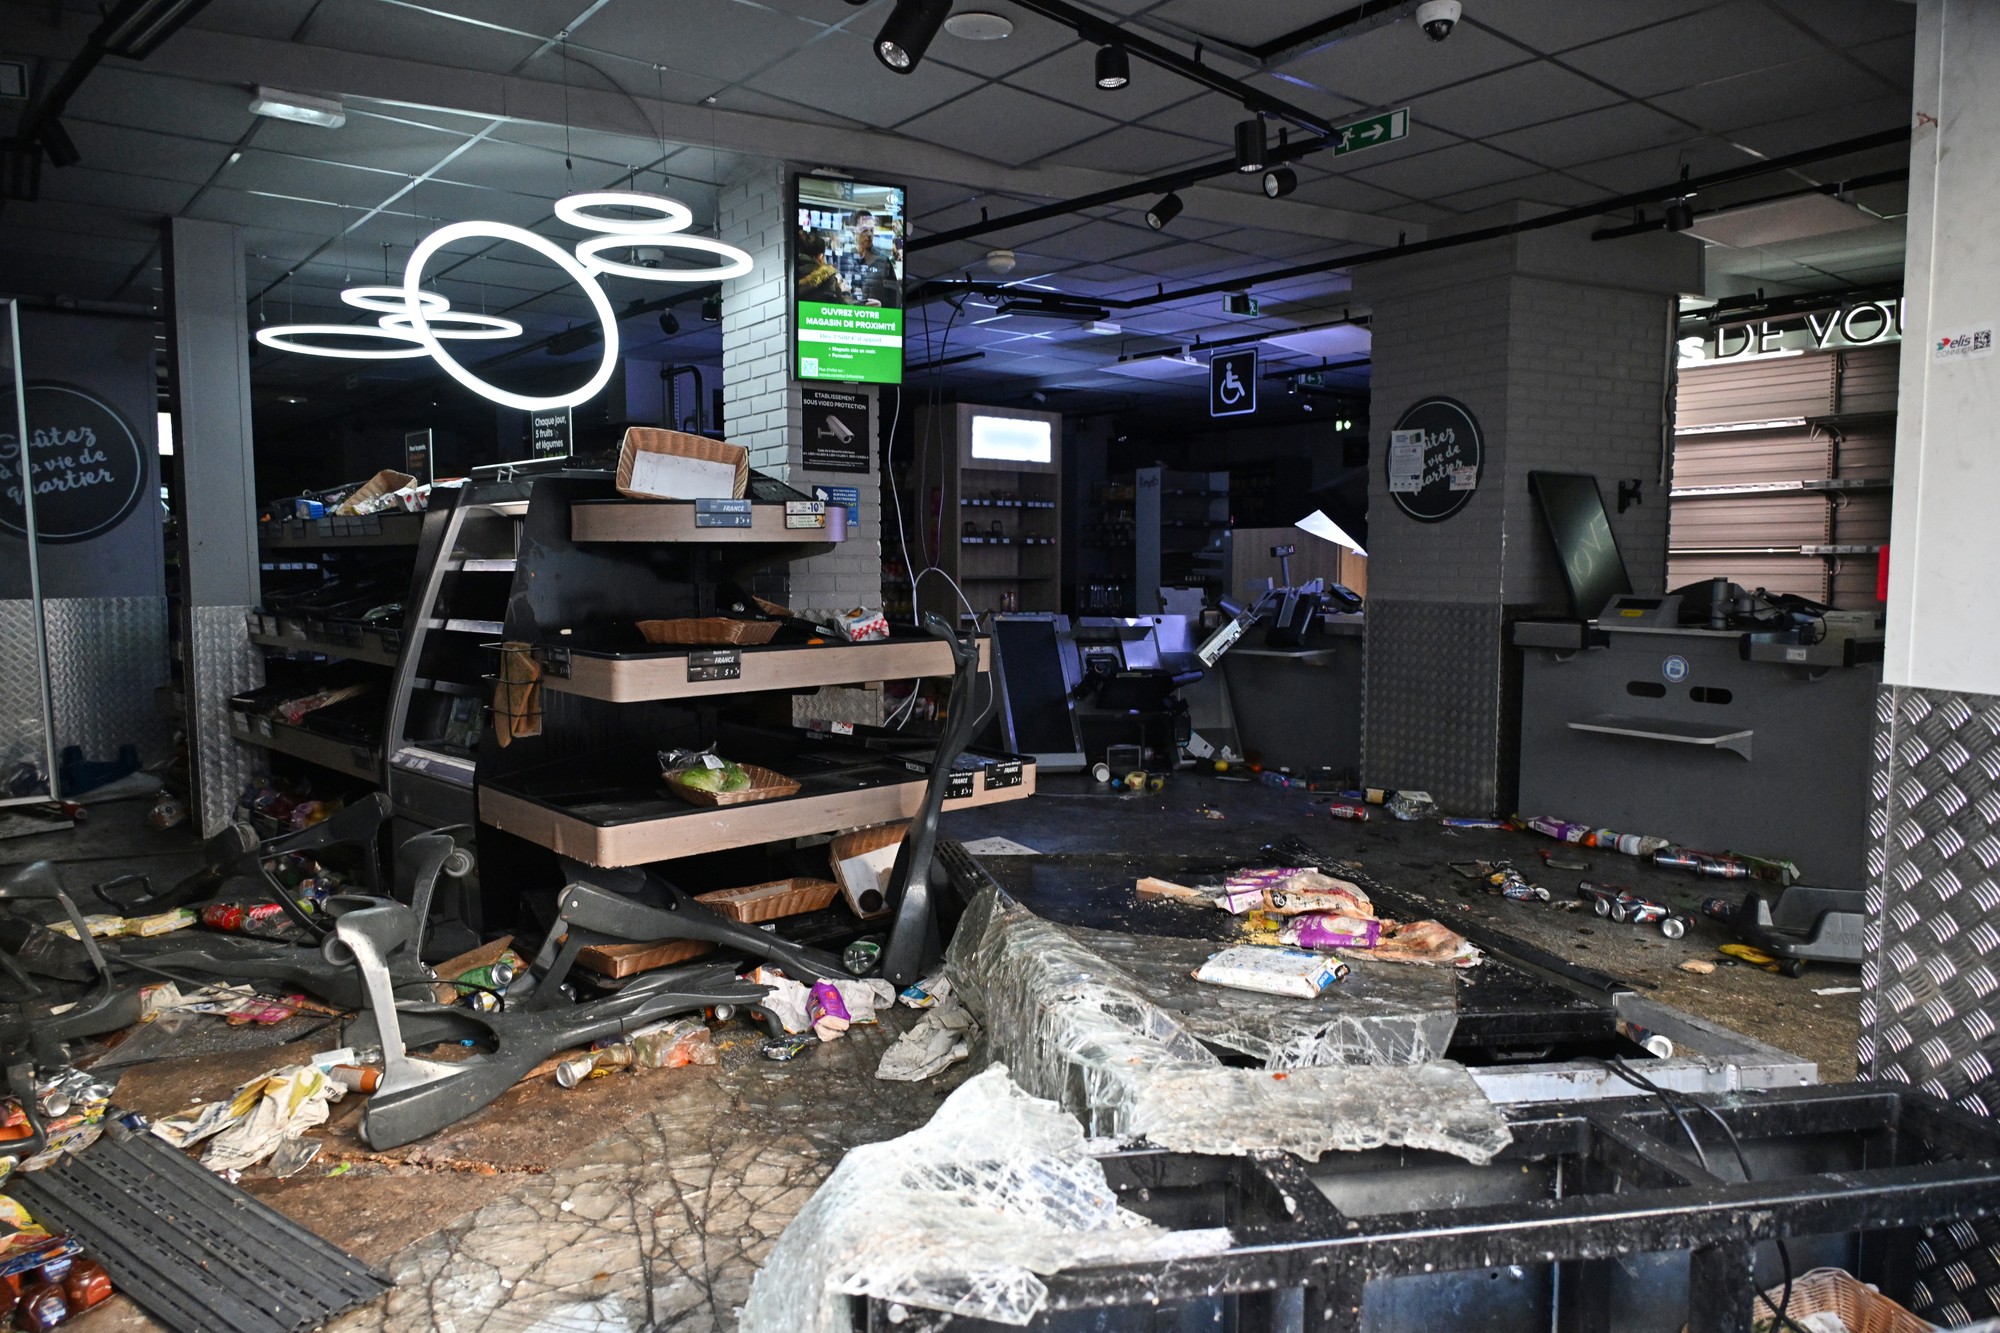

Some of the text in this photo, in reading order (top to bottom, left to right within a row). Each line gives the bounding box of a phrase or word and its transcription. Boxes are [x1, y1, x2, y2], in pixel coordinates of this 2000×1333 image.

[821, 307, 880, 319] OUVREZ VOTRE
[806, 317, 896, 331] MAGASIN DE PROXIMITÉ
[1715, 322, 1784, 360] DE
[1950, 334, 1971, 349] elis
[814, 392, 855, 402] ETABLISSEMENT
[834, 401, 867, 410] PROTECTION
[535, 417, 554, 427] Chaque
[535, 429, 553, 438] 5 fruits
[0, 427, 97, 459] Gûtez
[535, 440, 564, 450] et légumes
[44, 455, 76, 472] vie
[79, 448, 107, 465] de
[1427, 444, 1461, 467] vie de
[7, 468, 115, 506] qartier
[714, 656, 735, 664] FRANCE
